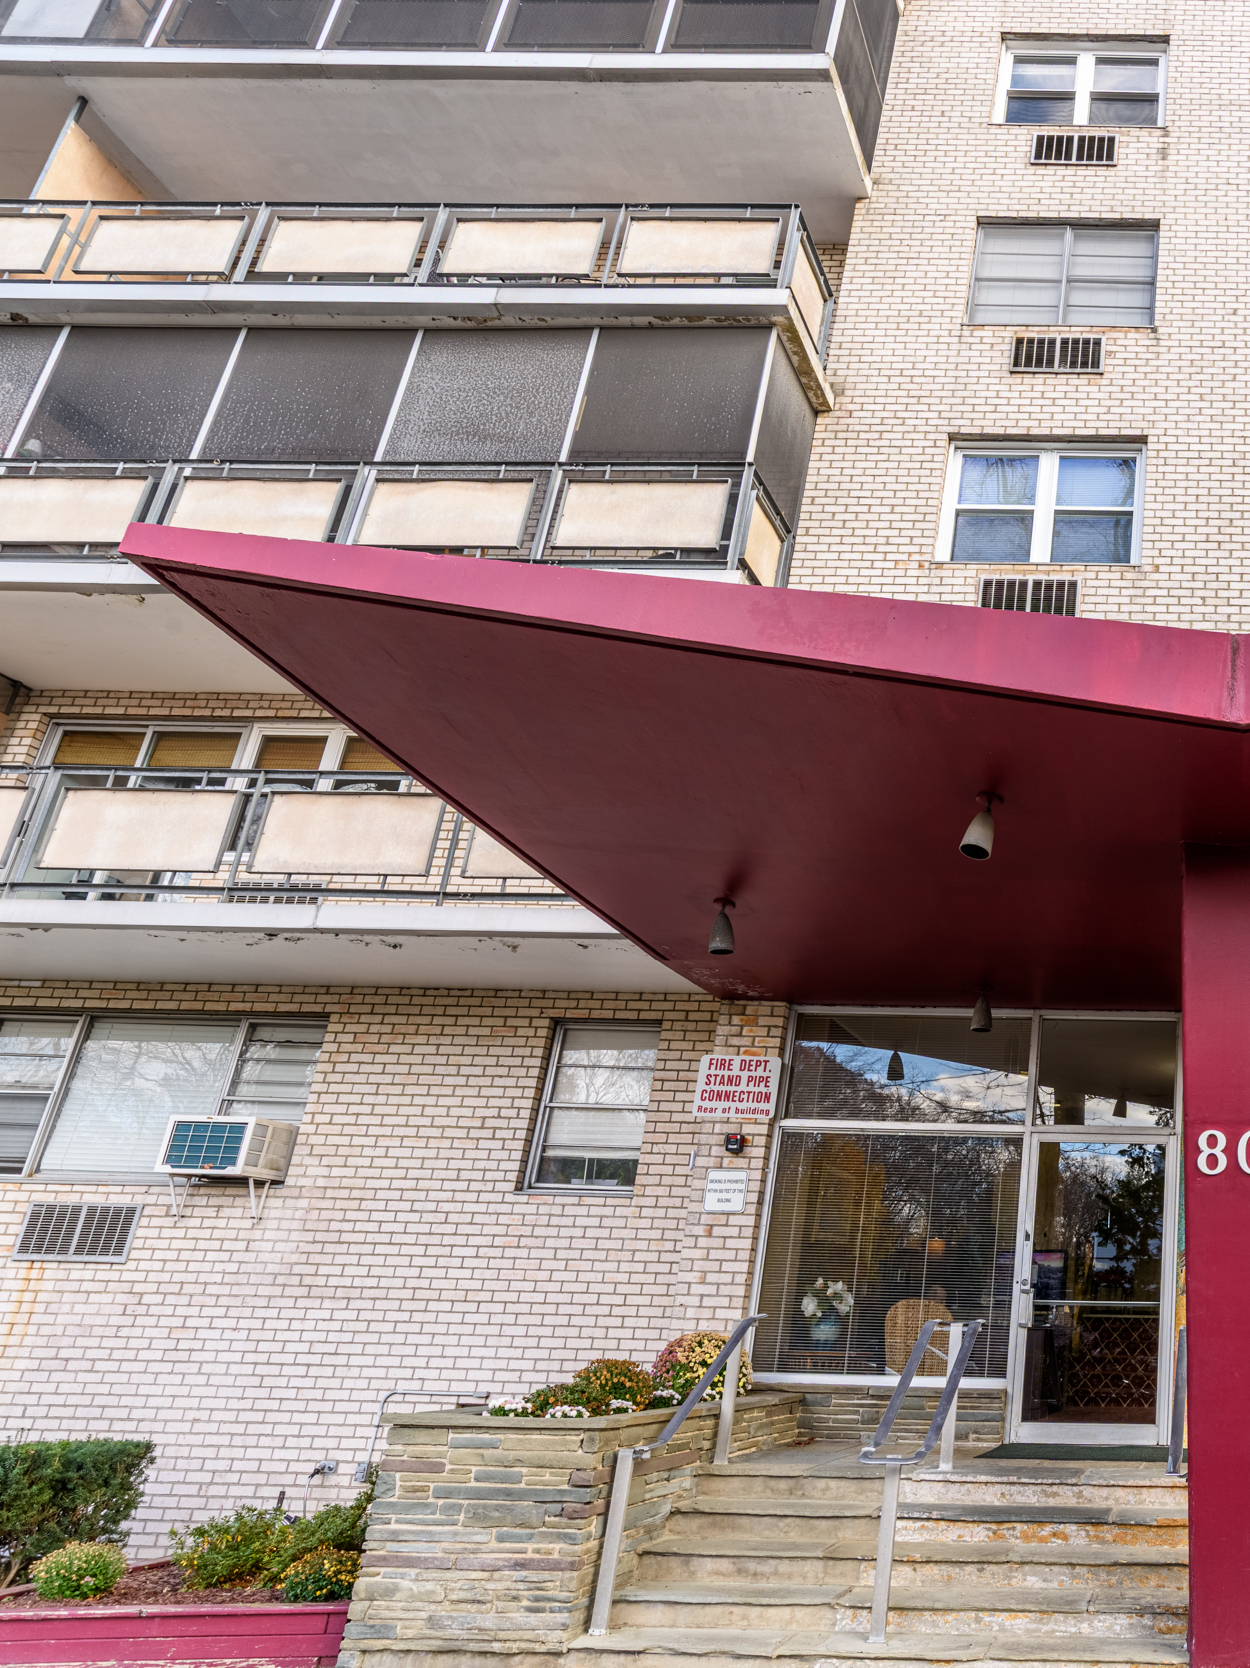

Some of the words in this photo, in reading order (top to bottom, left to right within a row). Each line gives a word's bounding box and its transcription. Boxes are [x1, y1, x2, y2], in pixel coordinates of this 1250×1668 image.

[708, 1058, 734, 1071] FIRE
[739, 1059, 772, 1073] DEPT.
[705, 1073, 742, 1087] STAND
[746, 1075, 771, 1088] PIPE
[700, 1089, 771, 1104] CONNECTION
[697, 1105, 718, 1114] Rear
[721, 1106, 731, 1114] of
[735, 1106, 770, 1117] building
